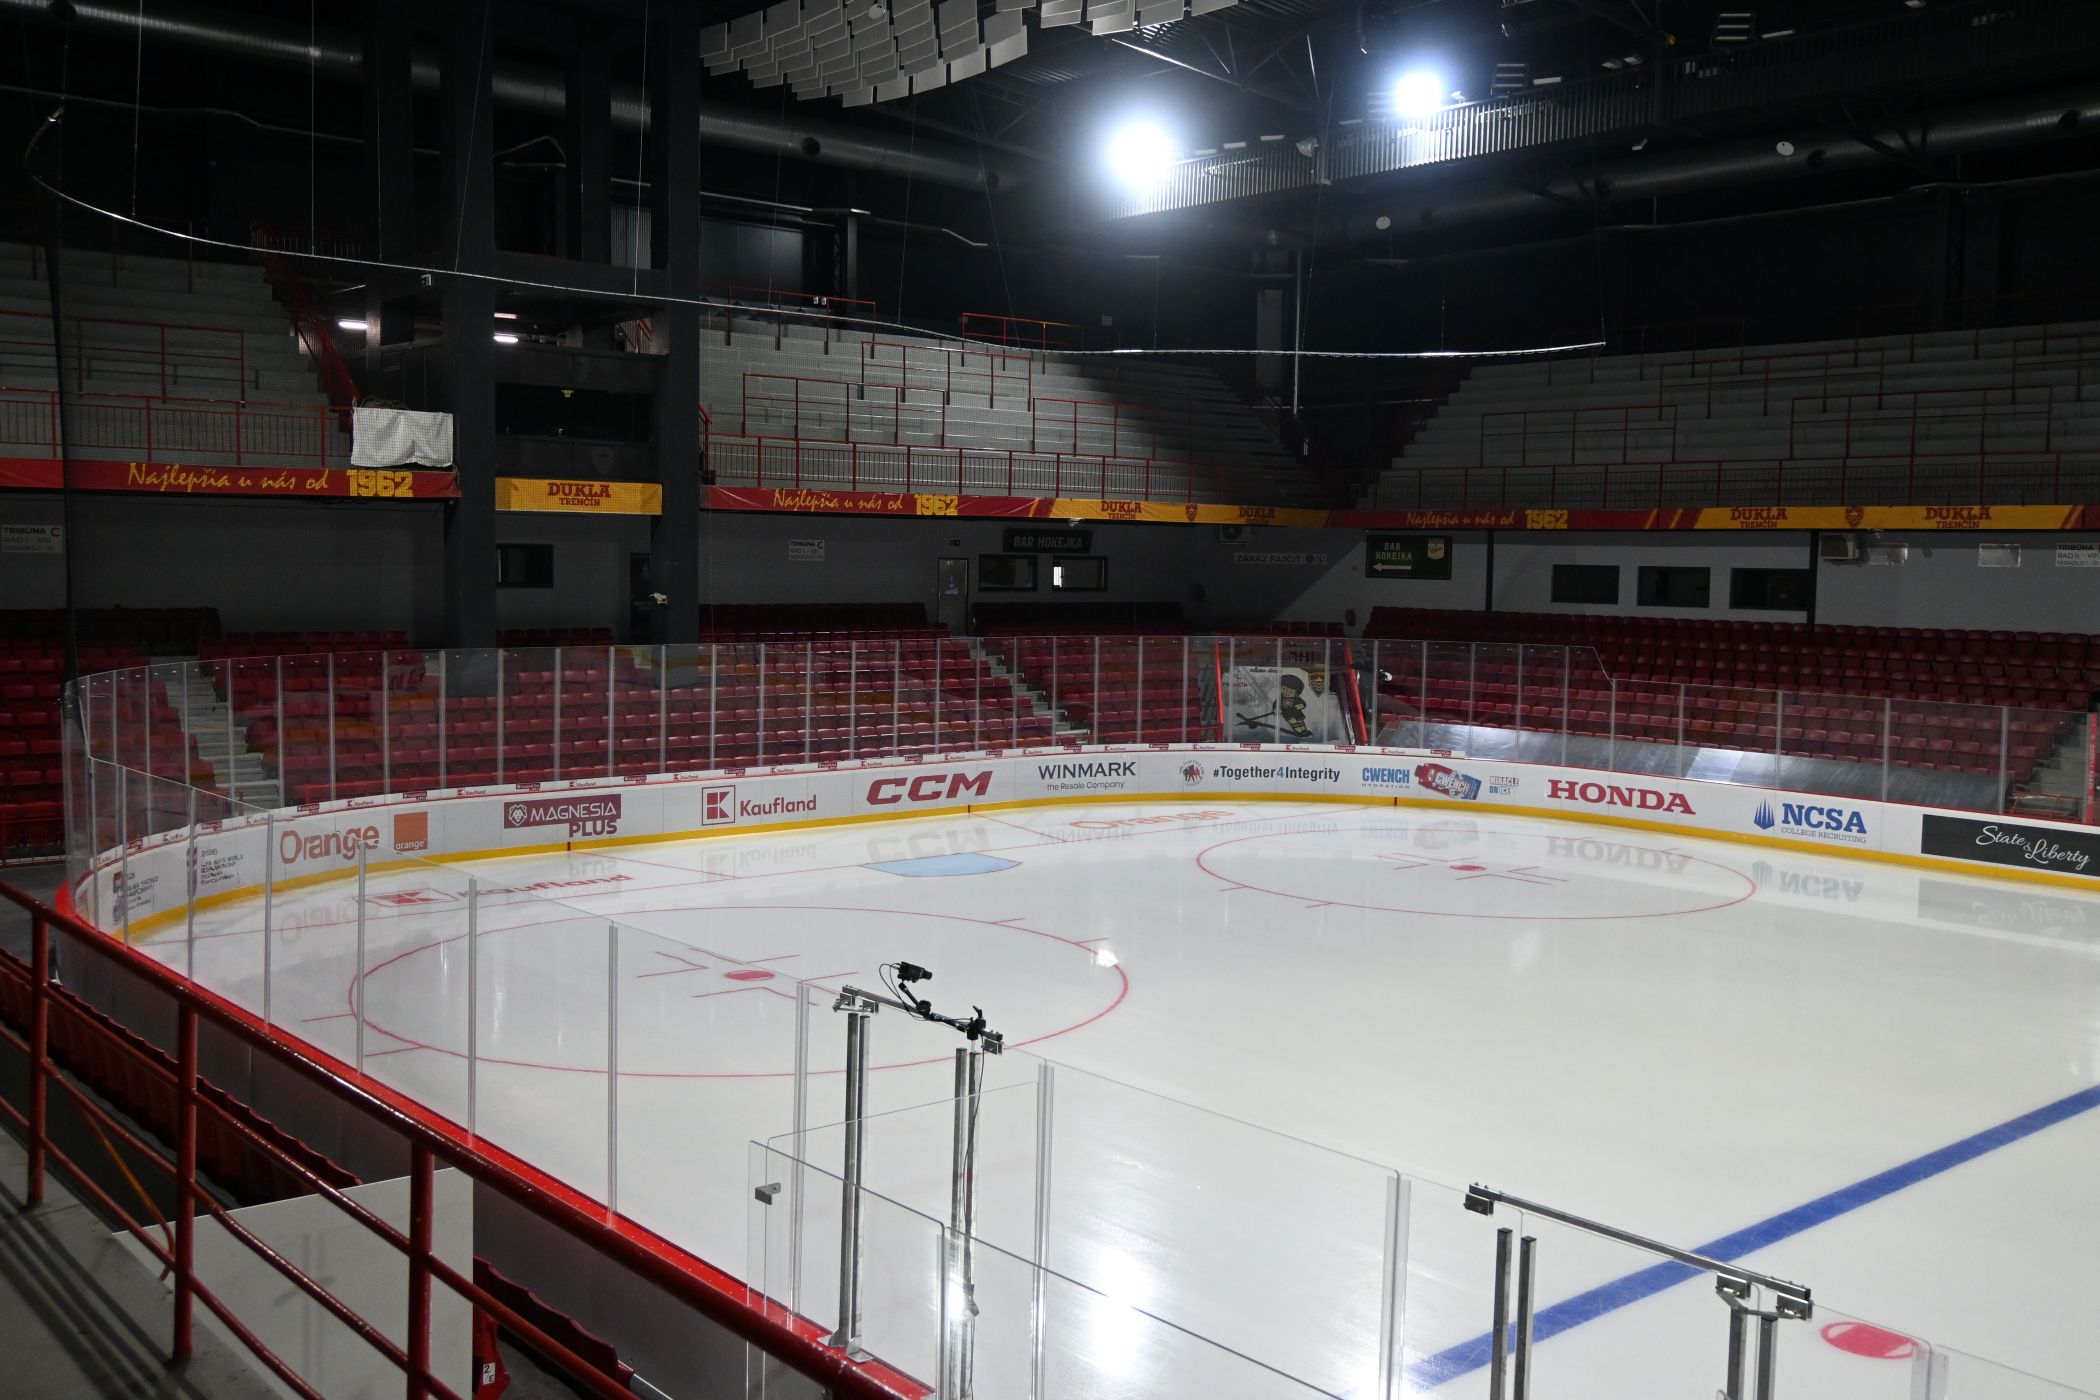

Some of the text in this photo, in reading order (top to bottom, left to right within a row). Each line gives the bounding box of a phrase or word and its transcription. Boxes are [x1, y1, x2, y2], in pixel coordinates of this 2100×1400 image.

[128, 463, 413, 497] Najlepšia u nás od 1962
[547, 482, 611, 498] DUKLA
[773, 488, 840, 512] Najlepšia
[845, 499, 853, 508] u
[888, 494, 903, 511] od
[914, 493, 959, 516] 1962
[1101, 501, 1142, 513] DUKLA
[1525, 509, 1568, 530] 1962
[1730, 507, 1788, 520] DUKLA
[1925, 506, 1992, 520] DUKLA
[1014, 536, 1083, 549] BAR HOKEJKA
[1384, 542, 1401, 551] BAR
[1038, 762, 1136, 780] WINMARK
[1362, 767, 1410, 784] CWENCH
[866, 770, 993, 806] CCM
[1047, 780, 1125, 792] the Resale Company
[740, 795, 816, 816] Kaufland
[1547, 779, 1696, 815] HONDA
[530, 802, 617, 822] MAGNESIA
[1070, 810, 1235, 830] Orange
[1782, 803, 1867, 834] NCSA
[569, 819, 618, 837] PLUS
[1781, 827, 1867, 844] COLLEGE RECRUITING
[280, 825, 380, 864] Orange
[395, 840, 424, 850] orange
[1976, 825, 2090, 870] State & Liberty
